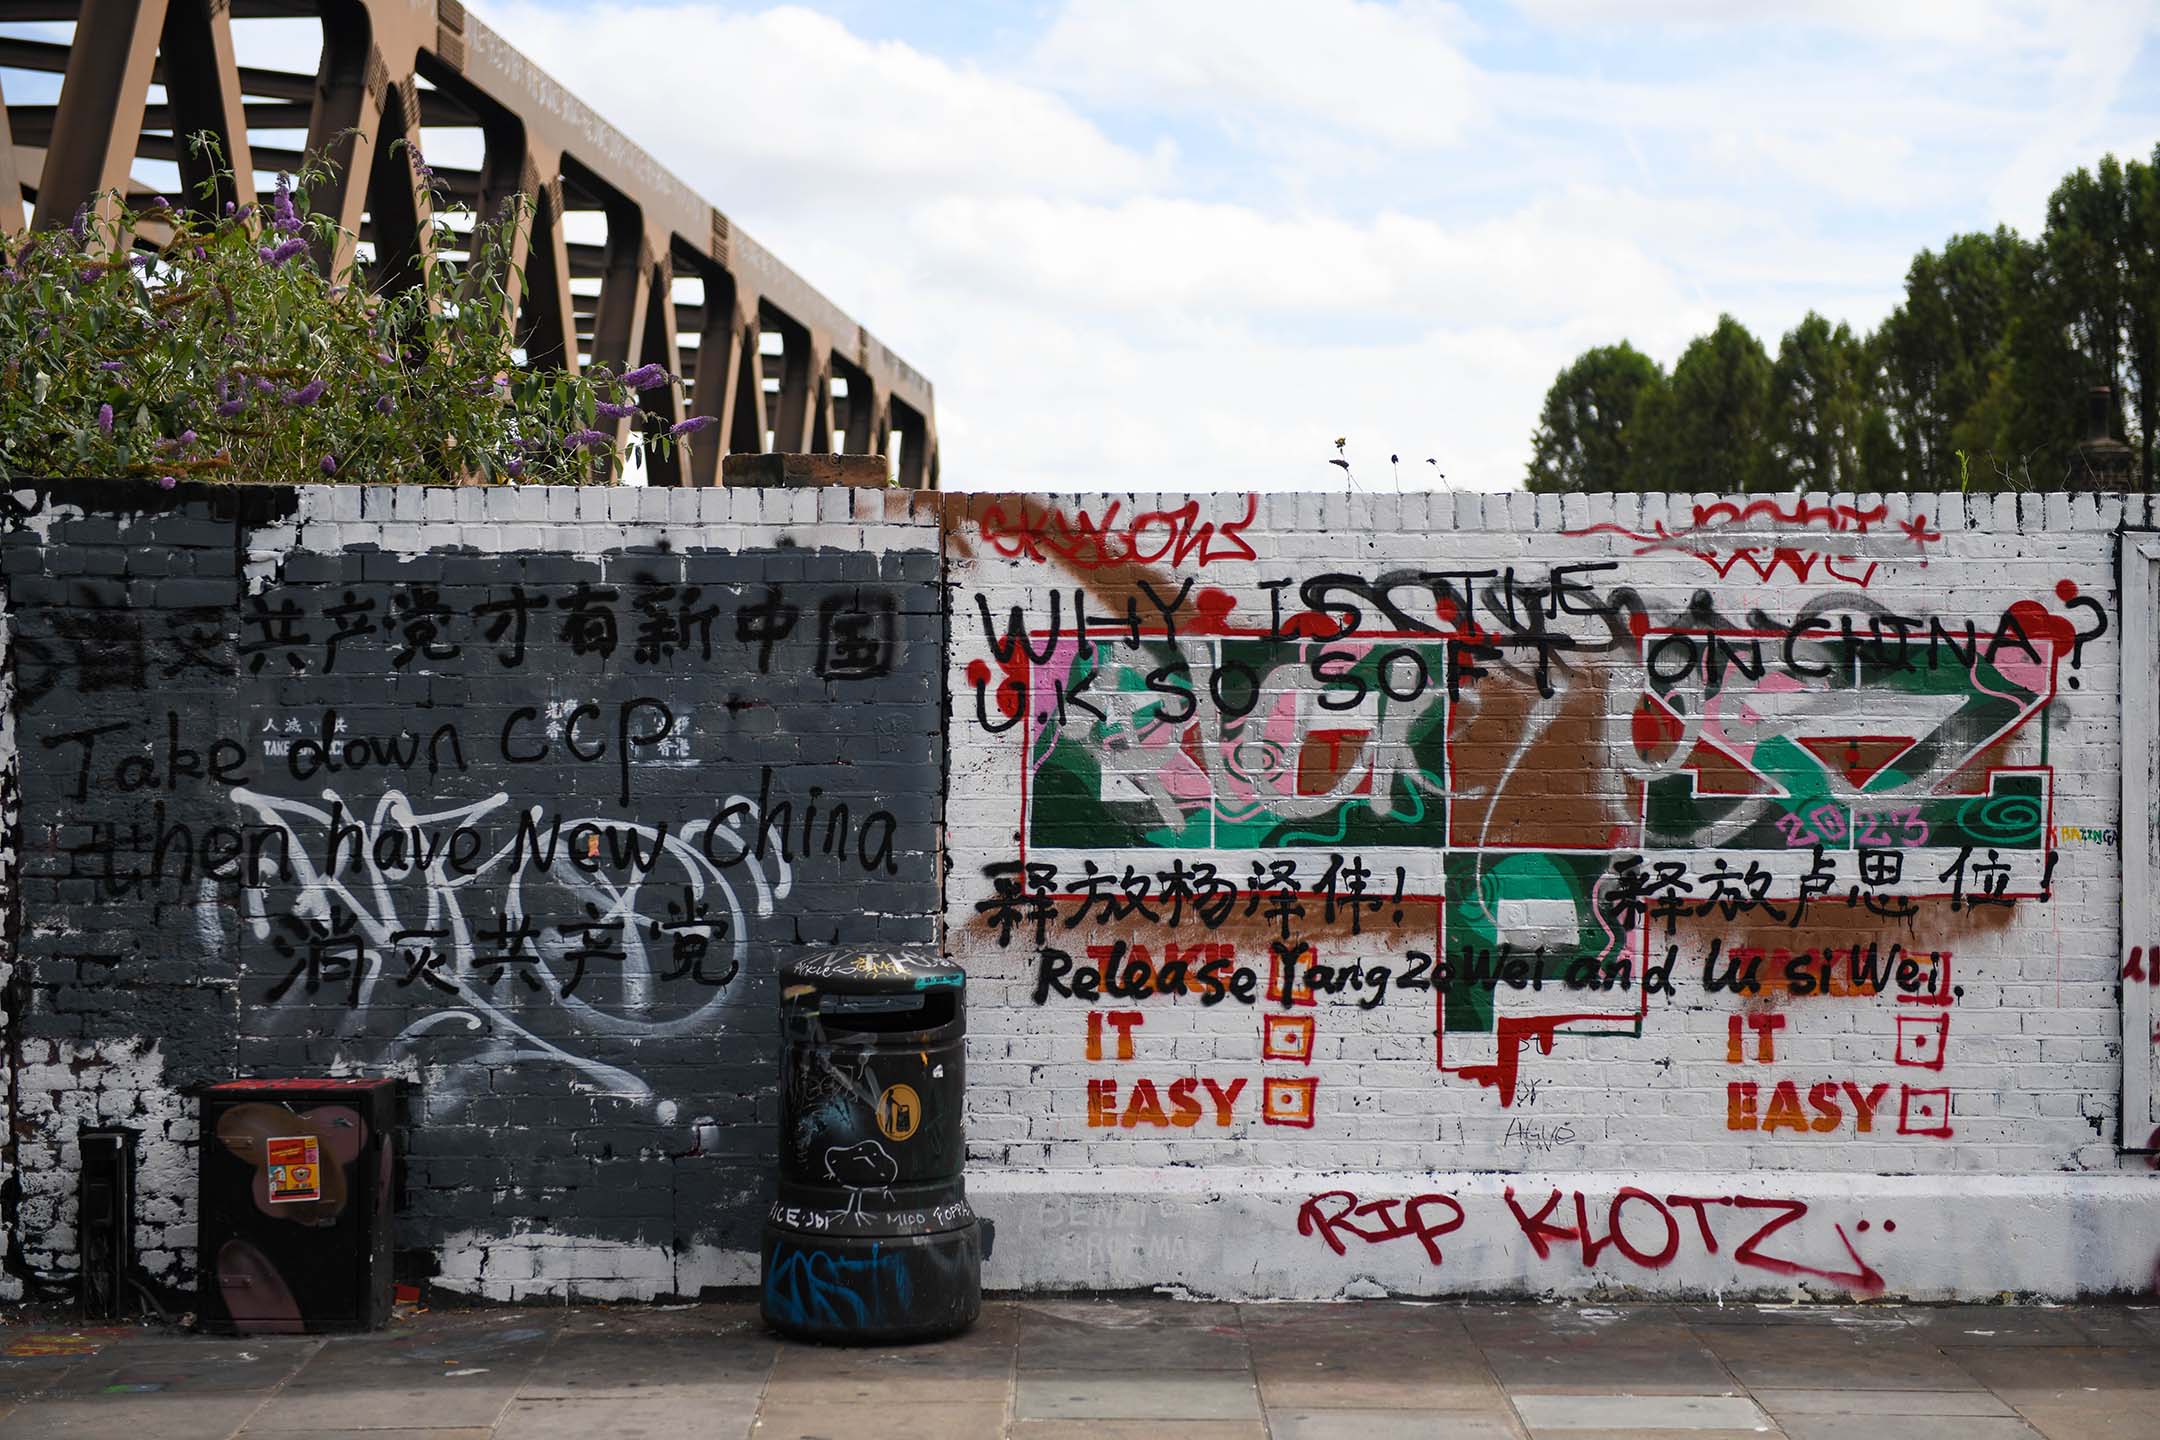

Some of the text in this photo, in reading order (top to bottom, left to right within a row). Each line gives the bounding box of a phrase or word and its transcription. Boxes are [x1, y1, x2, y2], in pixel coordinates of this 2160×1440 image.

[975, 577, 1195, 665] WHY
[1147, 658, 1262, 723] SO
[1310, 630, 1577, 711] SOFT
[1648, 628, 1765, 690] ON
[41, 696, 673, 807] Take down CCP
[325, 800, 481, 876] have
[509, 809, 668, 874] New
[1033, 940, 1256, 1006] Release
[1565, 946, 1677, 997] and
[1085, 1011, 1143, 1060] IT
[1727, 1014, 1786, 1063] IT
[1087, 1078, 1248, 1128] EASY
[1727, 1081, 1890, 1133] EASY
[1297, 1186, 1886, 1293] RIP KLOTZ
